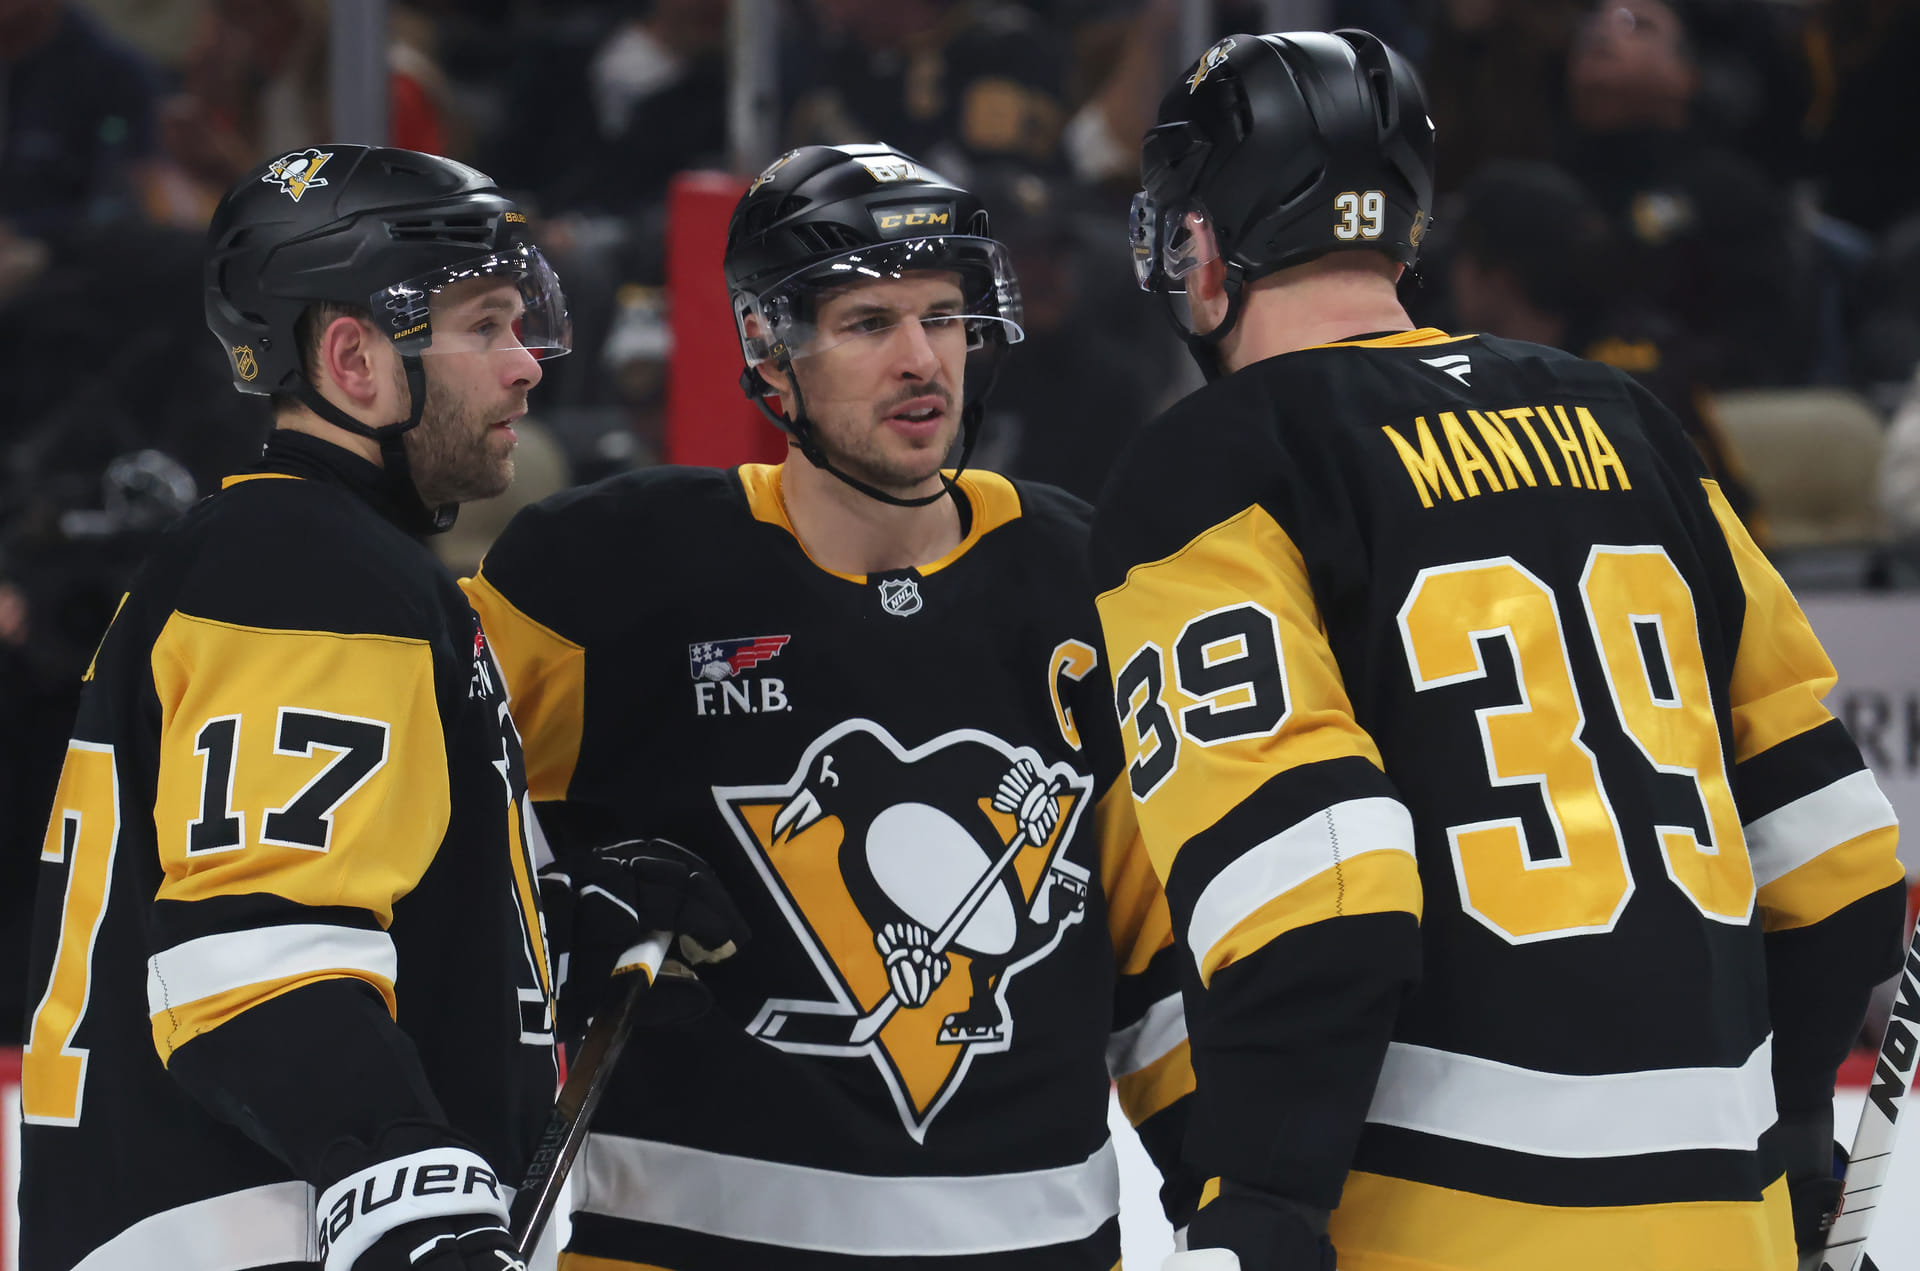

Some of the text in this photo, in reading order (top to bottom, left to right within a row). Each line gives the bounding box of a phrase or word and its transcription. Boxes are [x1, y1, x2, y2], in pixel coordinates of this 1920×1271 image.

[505, 212, 527, 223] BAUE
[880, 213, 949, 229] CCM
[1334, 190, 1386, 241] 39
[394, 322, 428, 340] BAUER
[1381, 405, 1633, 509] MANTHA
[891, 588, 912, 609] NHL
[695, 678, 793, 716] F.N.B.
[1048, 638, 1098, 752] C
[1115, 600, 1293, 804] 39
[186, 705, 391, 858] 17
[1396, 544, 1757, 946] 39
[1868, 915, 1920, 1126] NOVI
